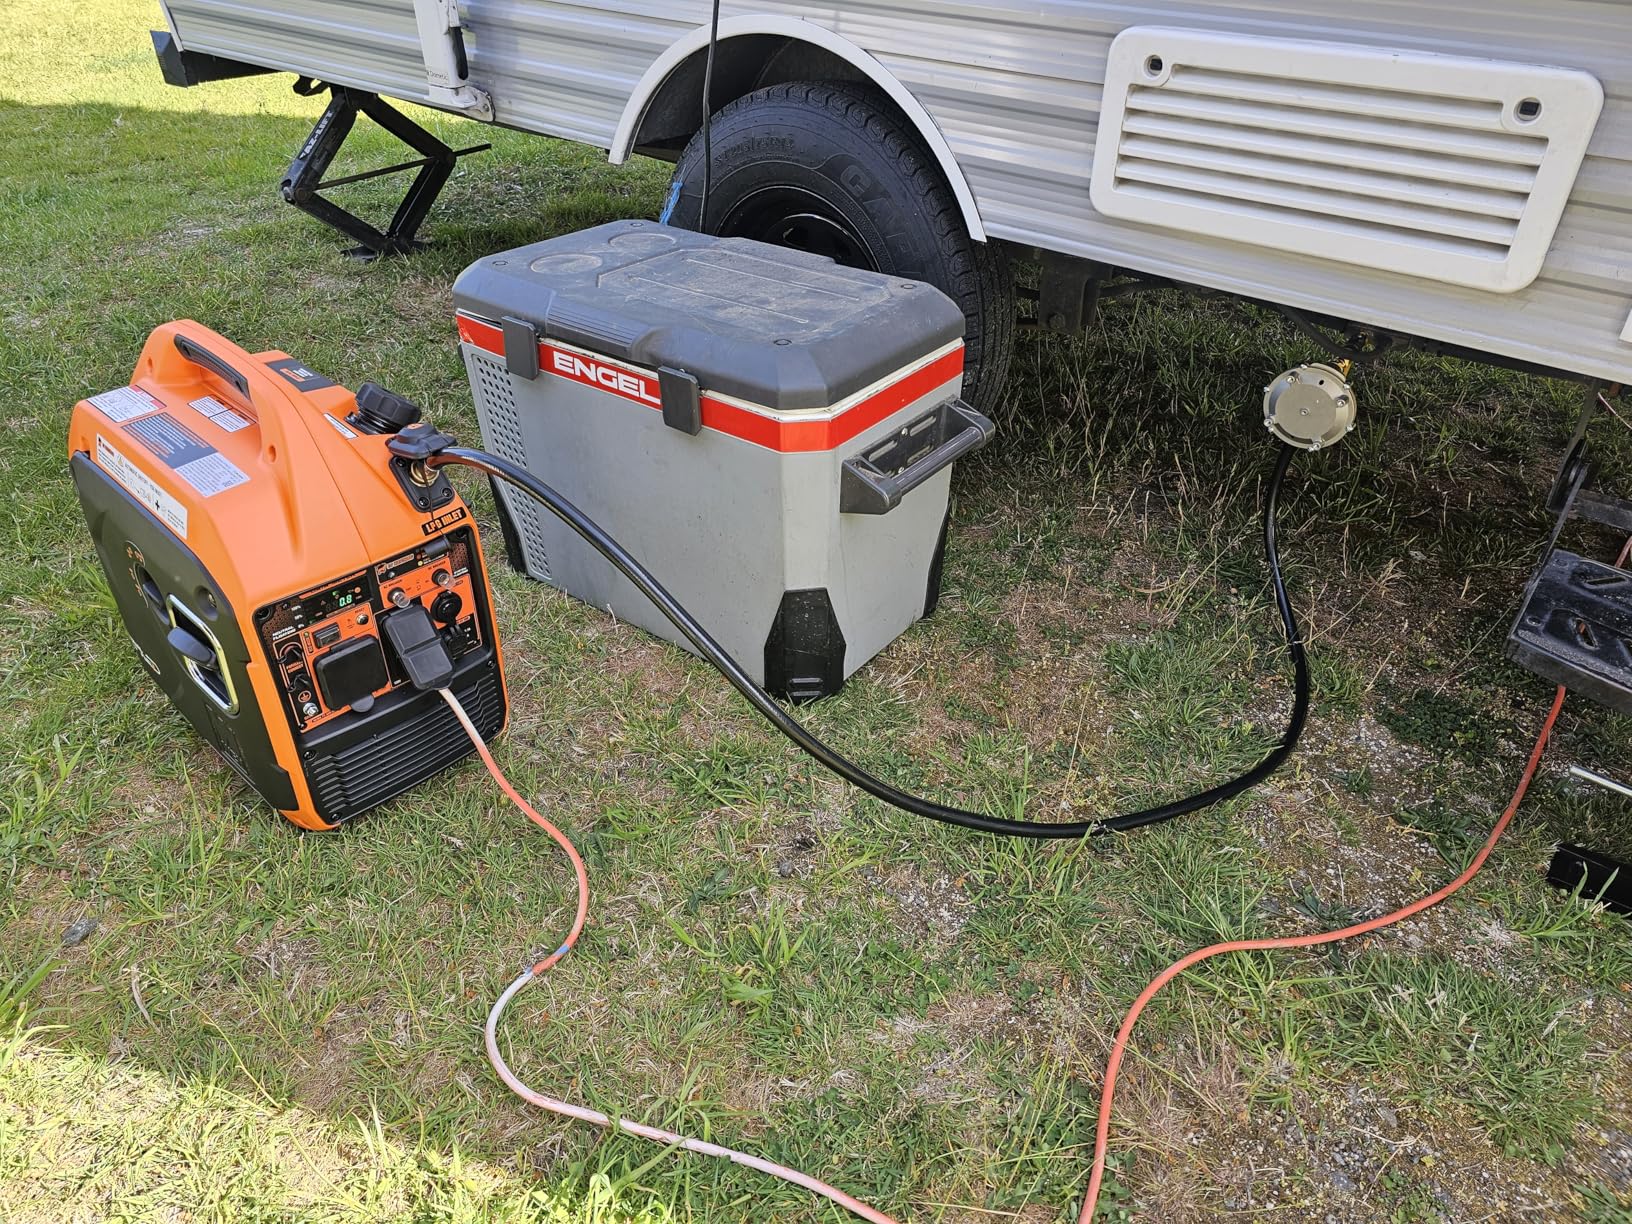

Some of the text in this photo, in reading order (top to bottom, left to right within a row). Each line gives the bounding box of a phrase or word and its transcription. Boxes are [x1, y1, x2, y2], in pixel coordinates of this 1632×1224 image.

[552, 350, 662, 405] ENGEL
[425, 510, 463, 533] LPG INLET
[339, 594, 353, 607] 0.8
